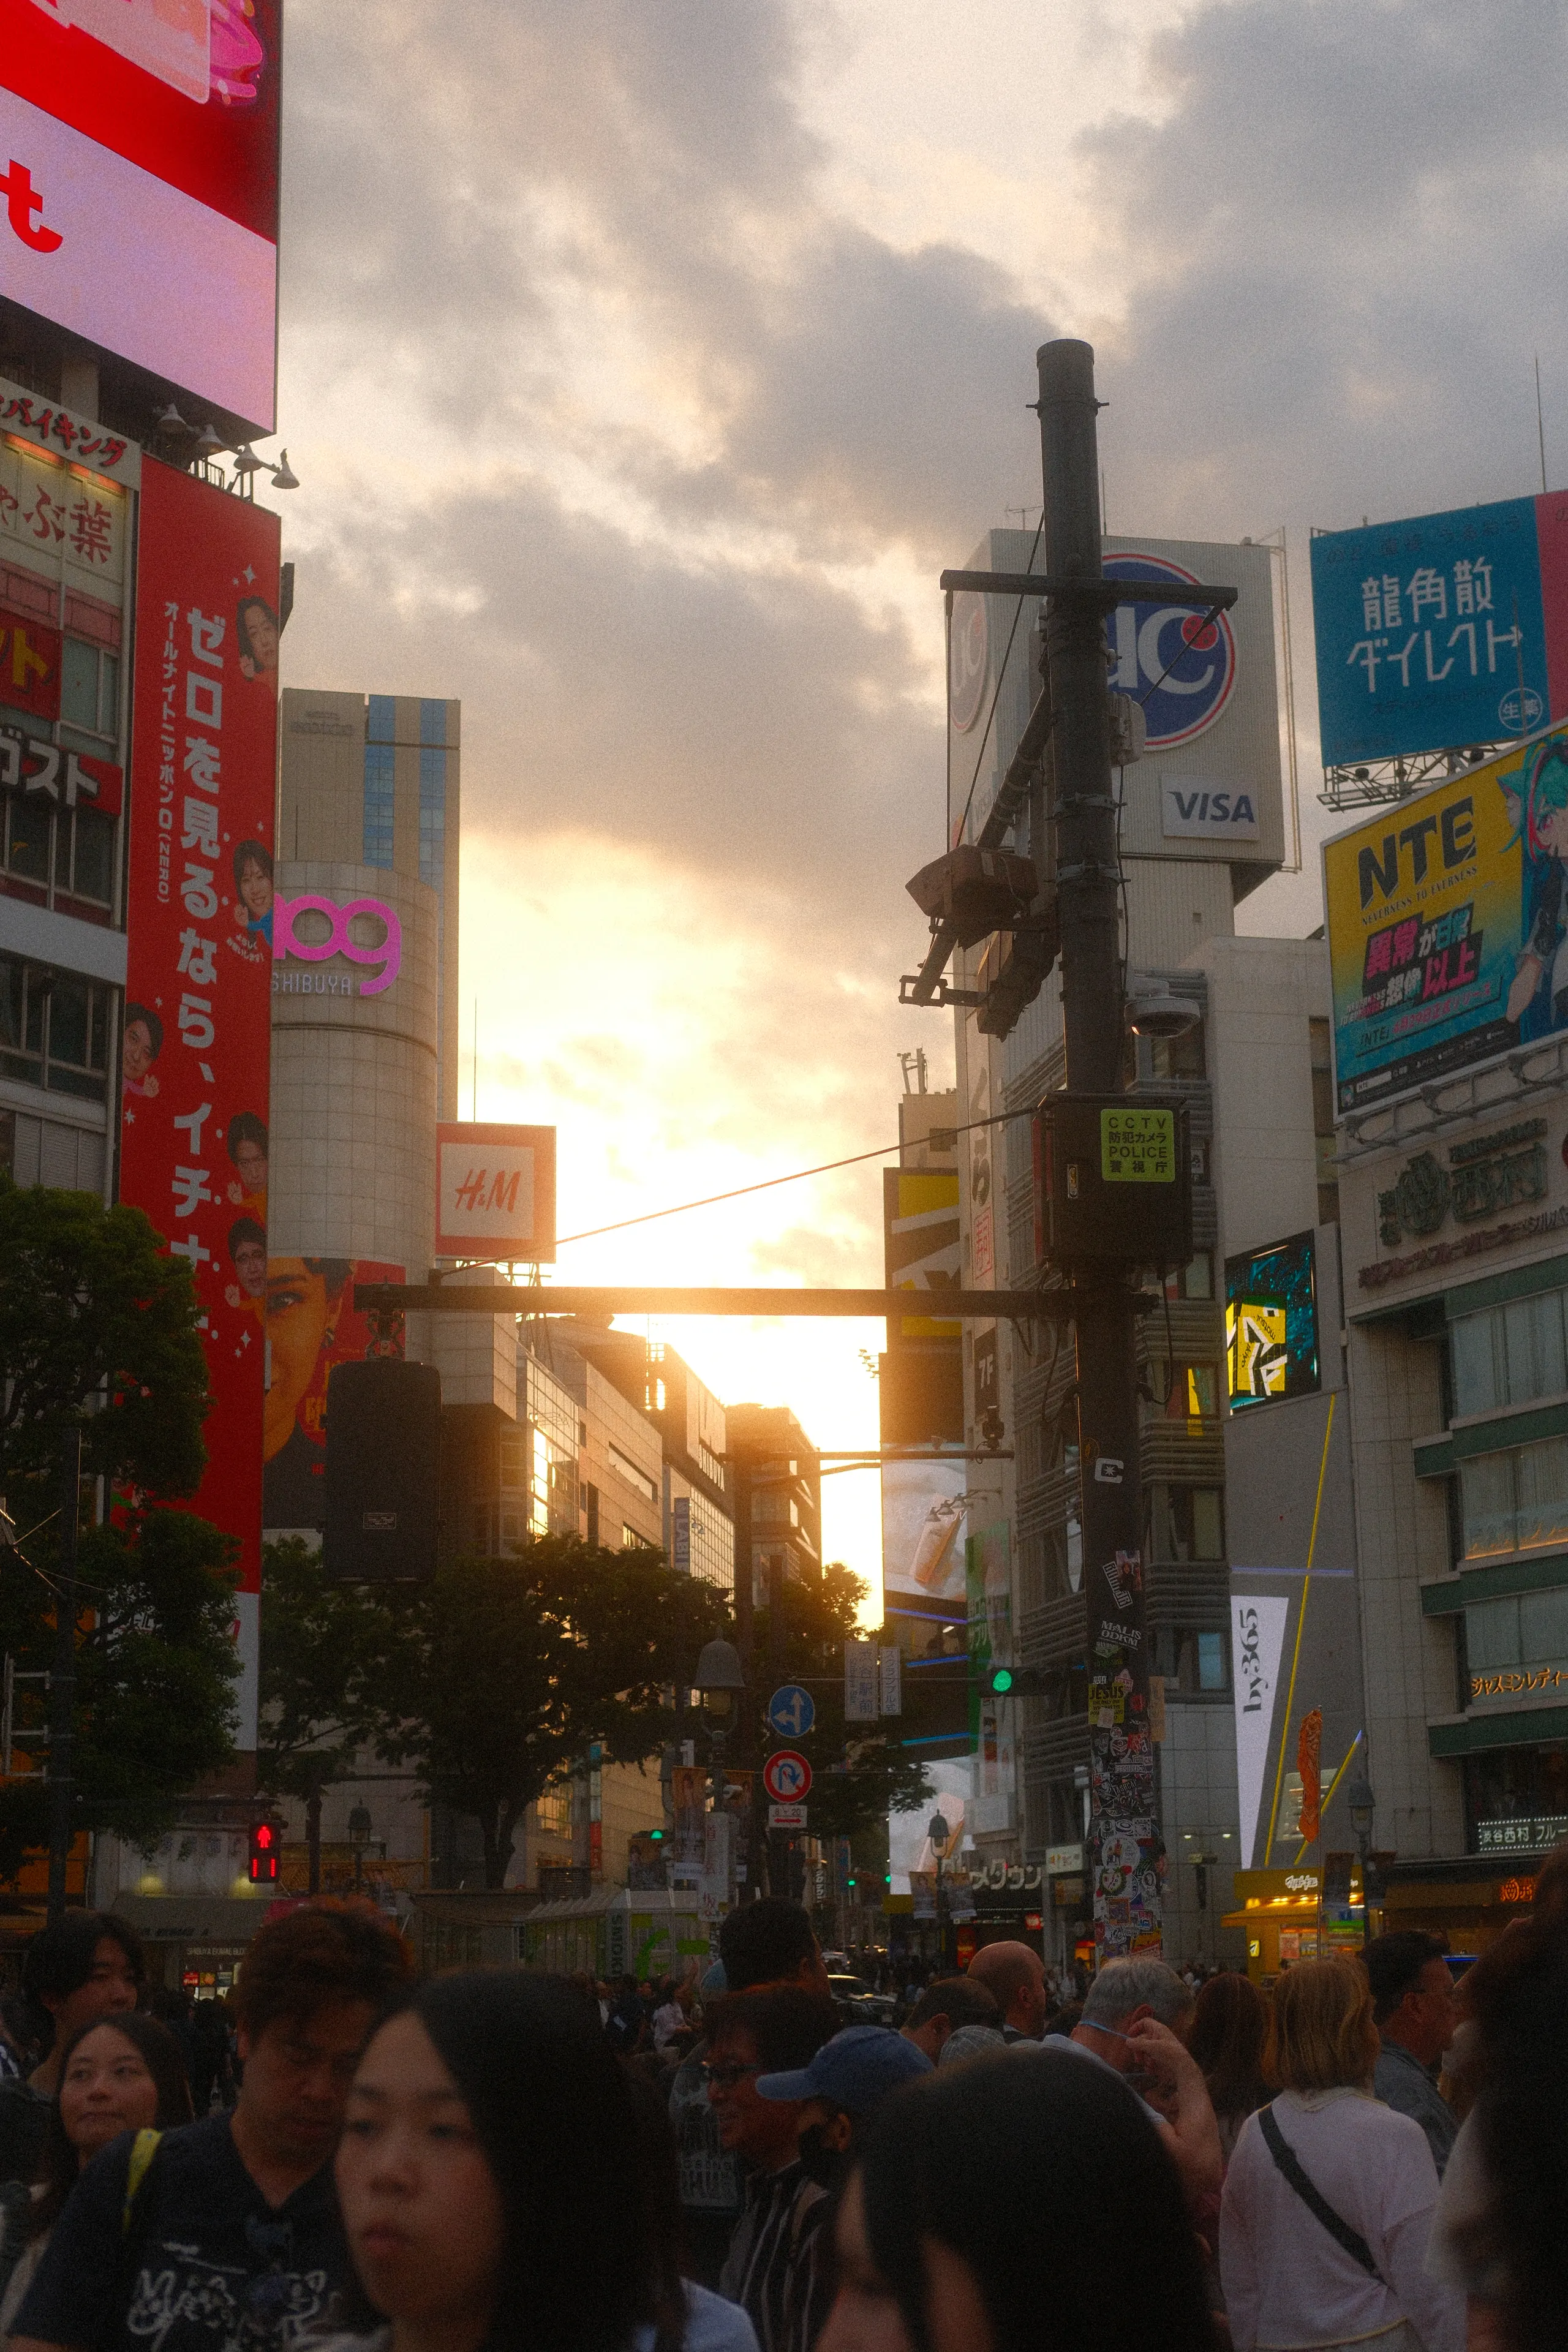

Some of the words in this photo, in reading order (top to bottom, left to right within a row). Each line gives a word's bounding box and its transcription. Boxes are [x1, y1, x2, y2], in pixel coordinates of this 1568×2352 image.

[0, 394, 127, 467] バイキング
[1361, 556, 1495, 632] 龍角散
[0, 627, 48, 687] ト
[1347, 619, 1523, 693] ダイレクト
[1167, 790, 1256, 824] VISA
[1357, 796, 1477, 913] NTE
[1362, 897, 1413, 926] NEVERNESS
[1415, 889, 1428, 903] TO
[1430, 865, 1478, 895] EVERNESS
[170, 606, 227, 1330] ゼロを見るなら、イチナ
[271, 972, 352, 995] SHIBUYA
[1108, 1131, 1168, 1145] 防犯カメラ
[1109, 1147, 1168, 1159] POLICE
[454, 1167, 522, 1213] H&M
[1109, 1159, 1168, 1174] 警視庁
[884, 1650, 897, 1713] スクランブル式
[1089, 1685, 1125, 1700] JESUS
[1483, 1828, 1537, 1849] 渋谷西村
